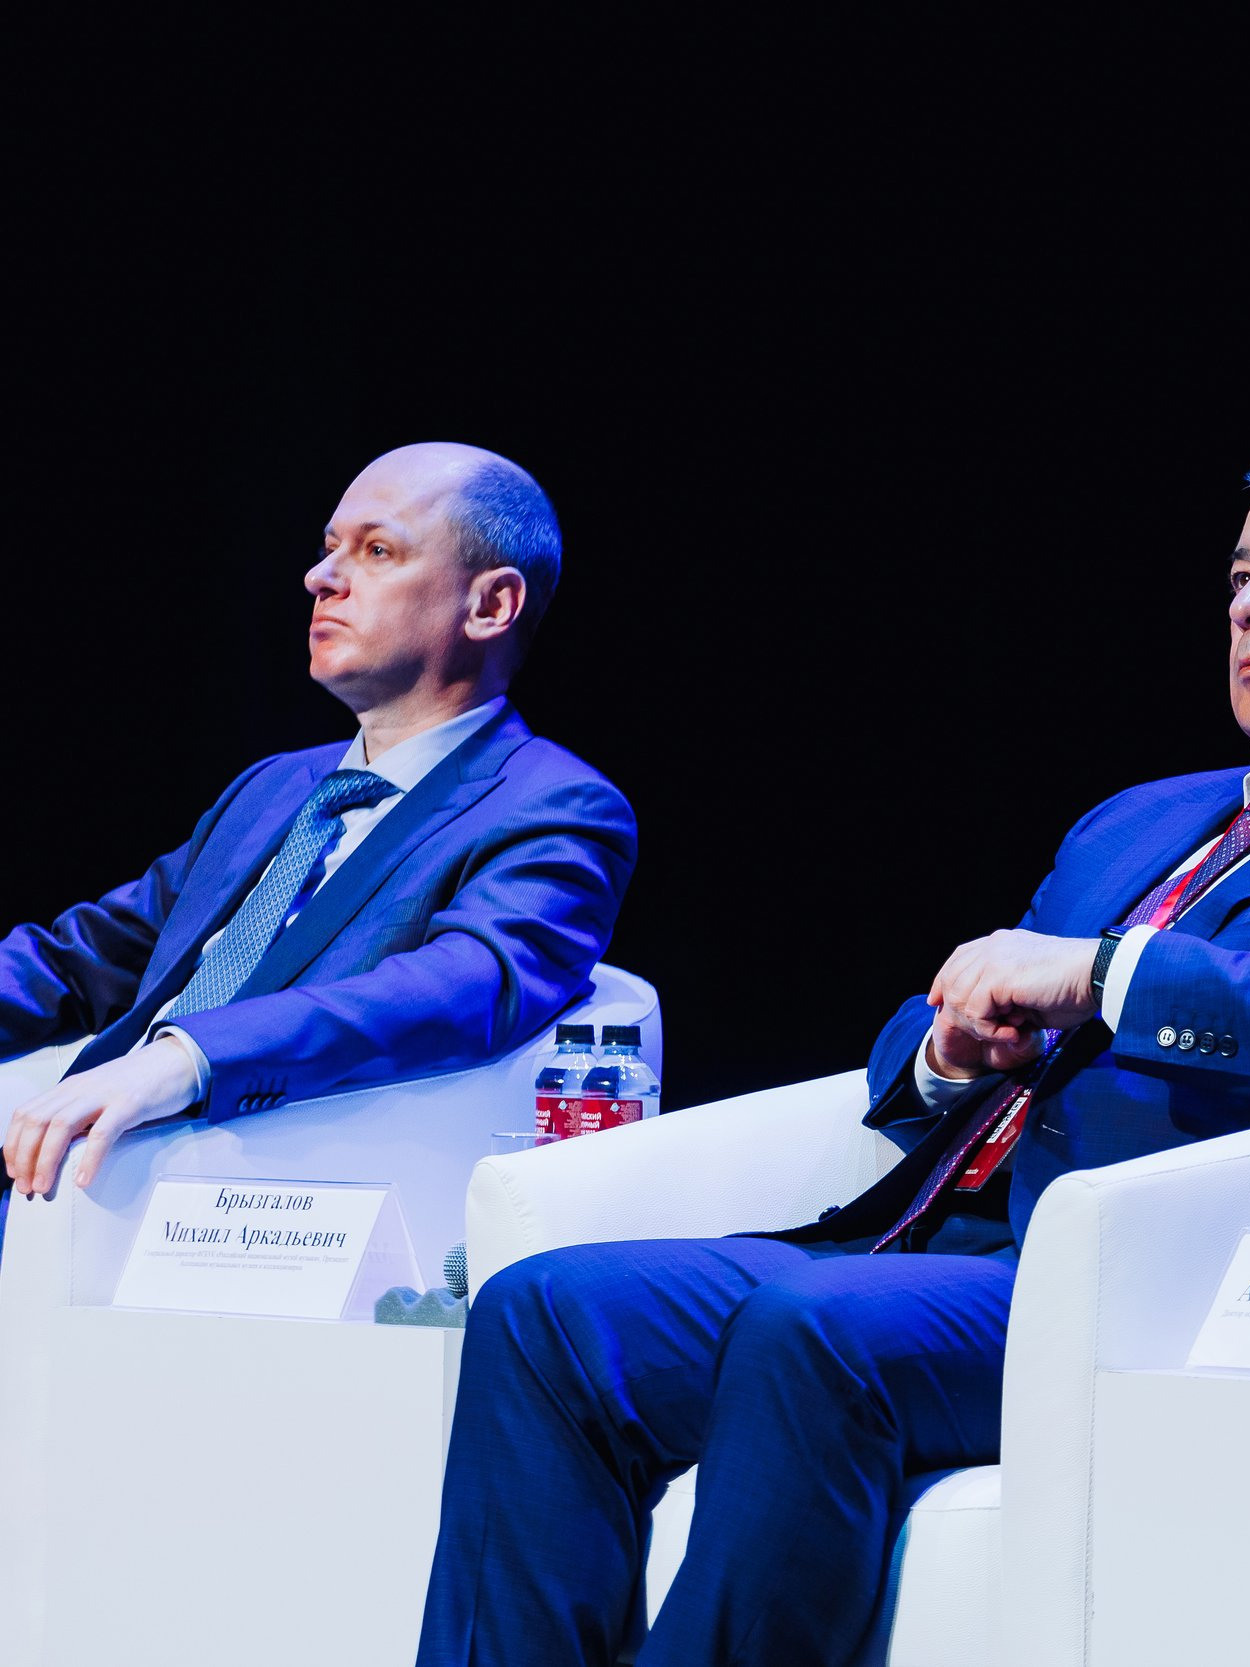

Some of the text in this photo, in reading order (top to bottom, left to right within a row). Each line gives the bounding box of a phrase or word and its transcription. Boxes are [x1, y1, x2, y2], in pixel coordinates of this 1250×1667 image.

[215, 1187, 314, 1214] Брызгалов
[161, 1221, 347, 1251] Михаил Аркадьевич
